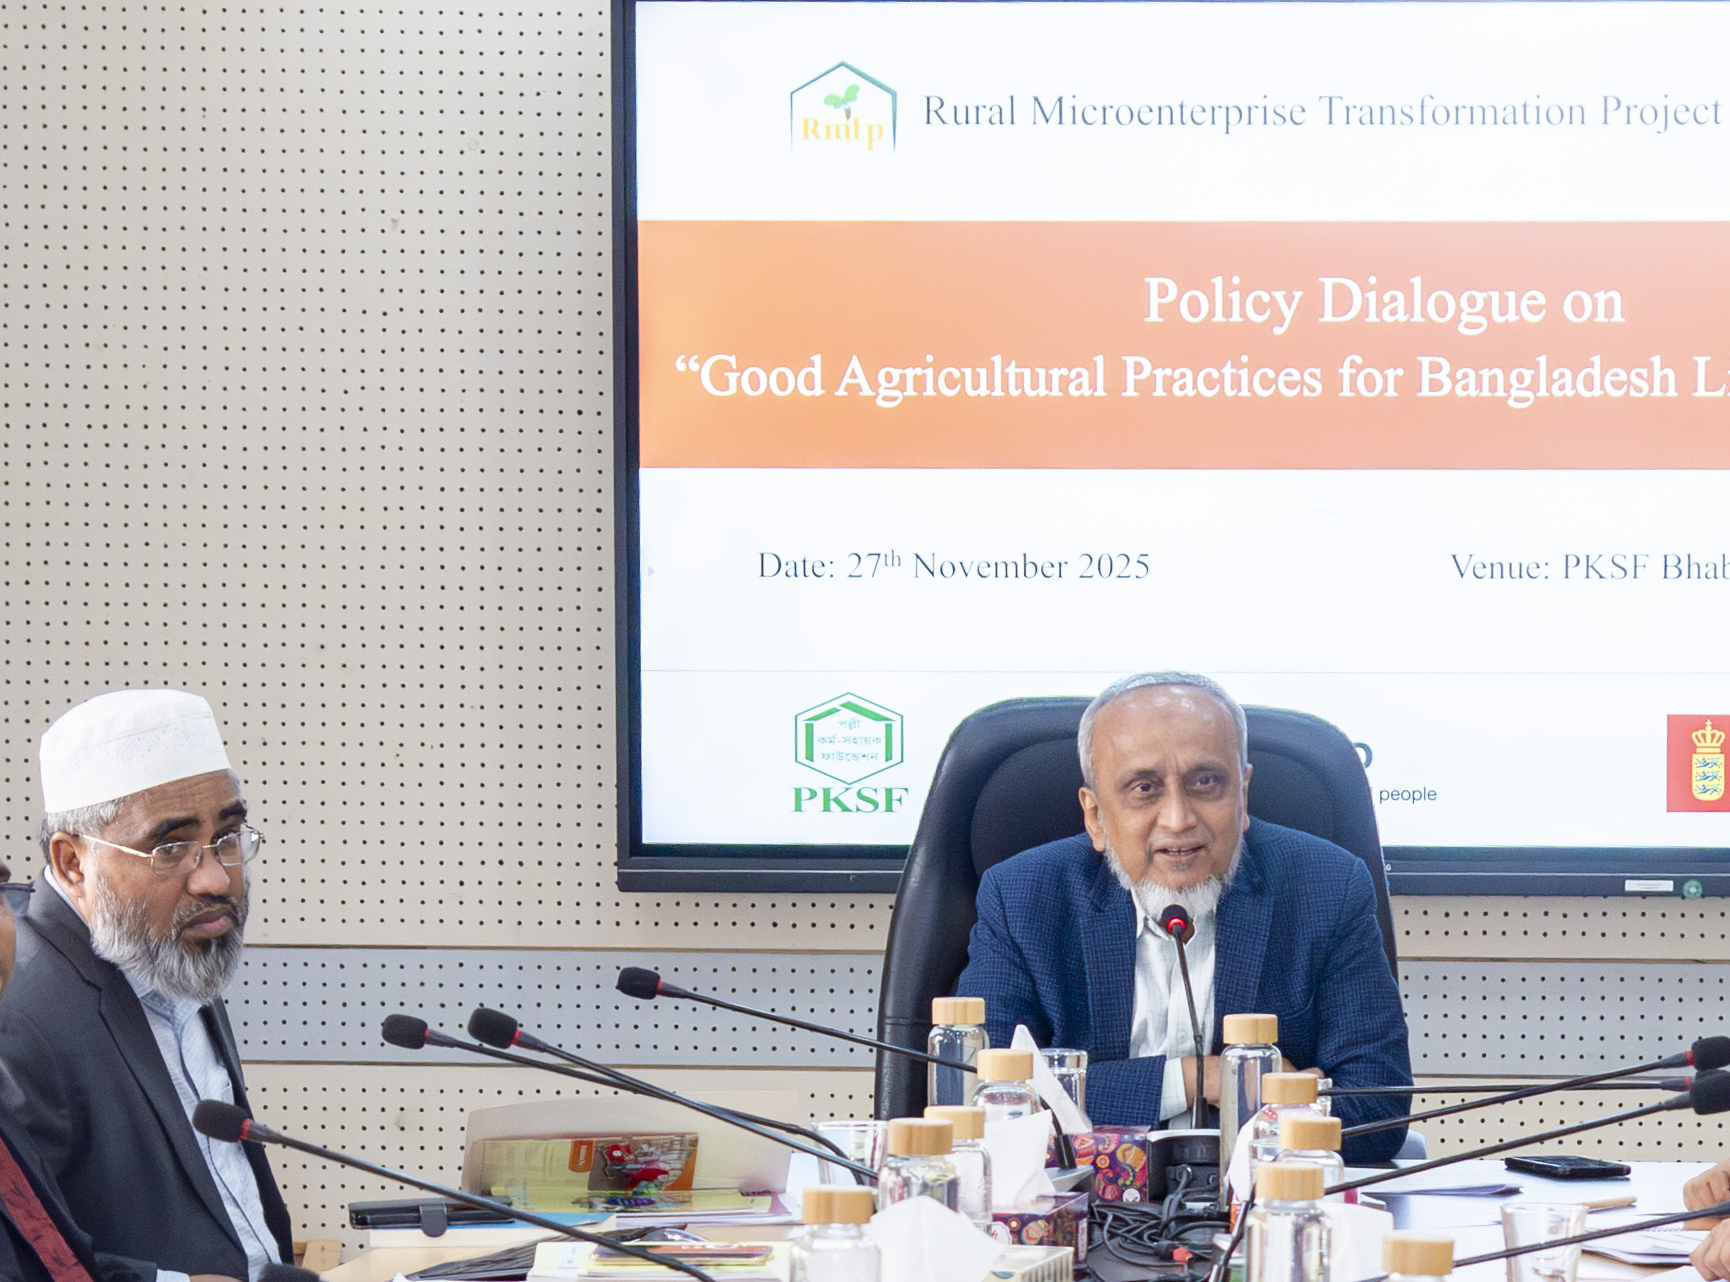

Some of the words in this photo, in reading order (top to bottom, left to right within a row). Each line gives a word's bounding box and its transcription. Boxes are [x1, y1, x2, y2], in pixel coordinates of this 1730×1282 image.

[925, 94, 1017, 126] Rural
[1031, 94, 1307, 135] Microenterprise
[1319, 94, 1588, 126] Transformation
[1602, 94, 1723, 135] Project
[801, 116, 884, 151] Rmtp
[1144, 276, 1305, 336] Policy
[1319, 276, 1548, 336] Dialogue
[1563, 290, 1627, 324] on
[674, 354, 829, 398] “Good
[833, 354, 1109, 411] Agricultural
[1122, 354, 1324, 399] Practices
[1338, 354, 1406, 399] for
[1416, 354, 1680, 411] Bangladesh
[758, 552, 835, 580] Date:
[848, 547, 903, 580] 27th
[914, 552, 1070, 580] November
[1079, 552, 1151, 581] 2025
[1451, 554, 1551, 581] Venue:
[1563, 554, 1653, 581] PKSF
[792, 786, 909, 813] PKSF
[1379, 787, 1437, 805] people
